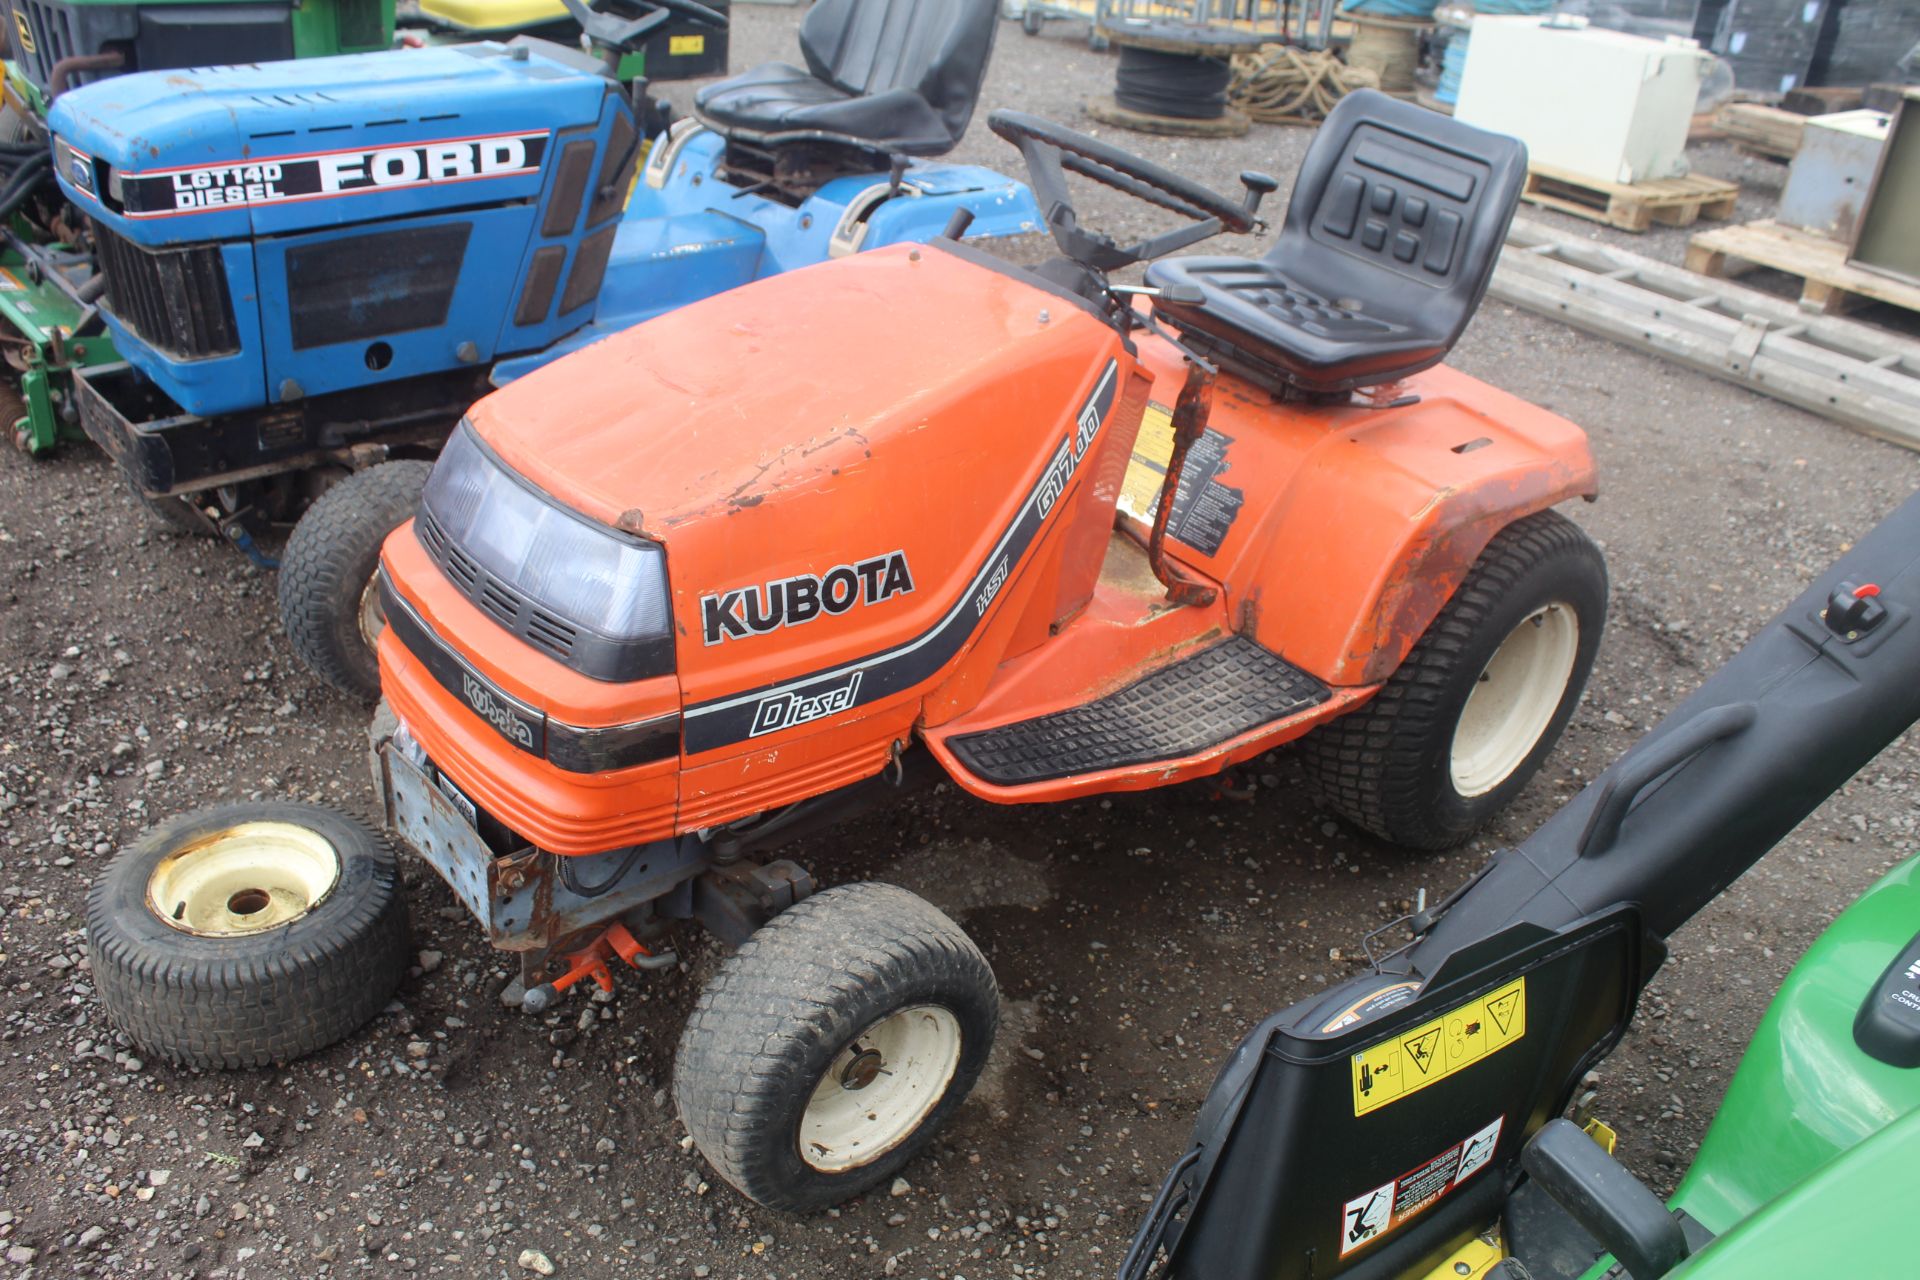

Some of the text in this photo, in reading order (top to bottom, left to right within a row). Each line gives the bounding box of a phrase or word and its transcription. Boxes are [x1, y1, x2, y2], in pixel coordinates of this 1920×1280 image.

[173, 164, 283, 191] LGT14D
[318, 138, 526, 192] FORD
[174, 182, 285, 209] DIESEL
[701, 549, 915, 646] KUBOTA
[976, 553, 1009, 617] HST
[749, 671, 863, 738] Diesel
